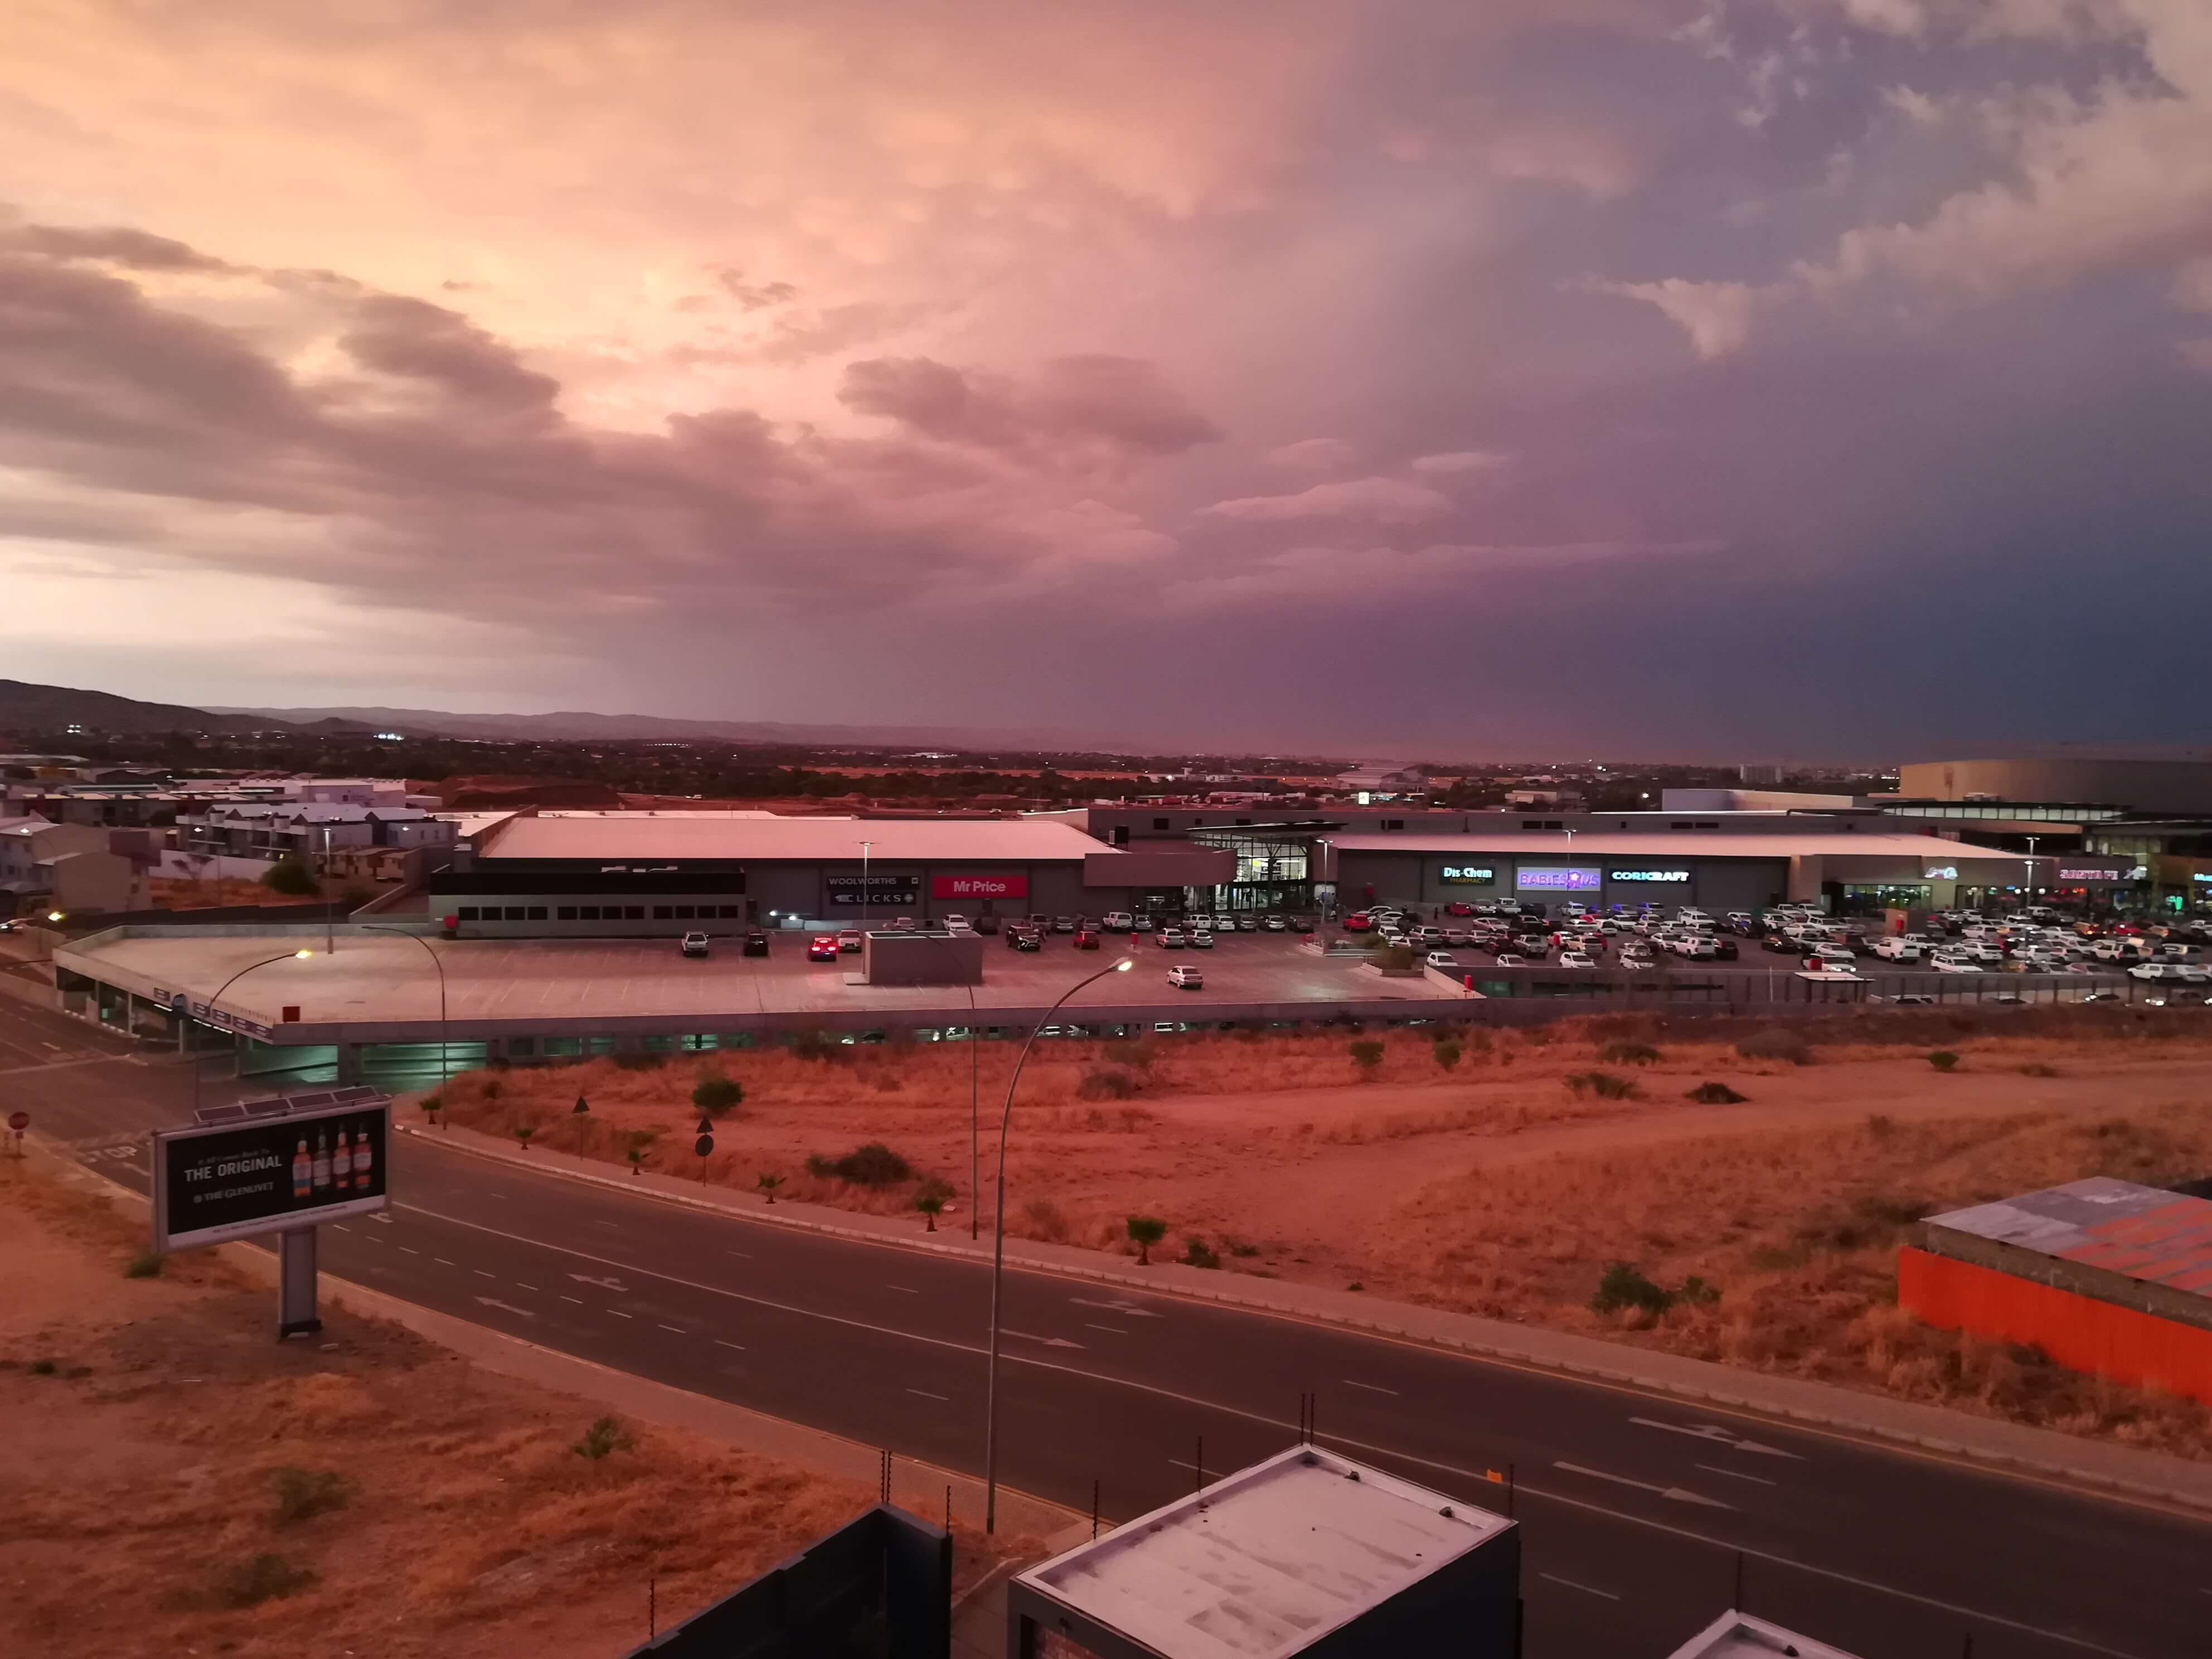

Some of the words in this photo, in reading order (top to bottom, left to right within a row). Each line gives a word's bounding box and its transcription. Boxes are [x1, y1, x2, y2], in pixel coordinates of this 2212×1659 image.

[1444, 867, 1492, 878] Dis-Chem
[1612, 871, 1689, 881] CORICRAFT
[954, 881, 971, 892] Mr
[973, 881, 1006, 892] Price
[184, 1166, 212, 1182] THE
[217, 1155, 283, 1177] ORIGINAL
[204, 1191, 223, 1201] THE
[225, 1181, 274, 1199] GLENLIVET
